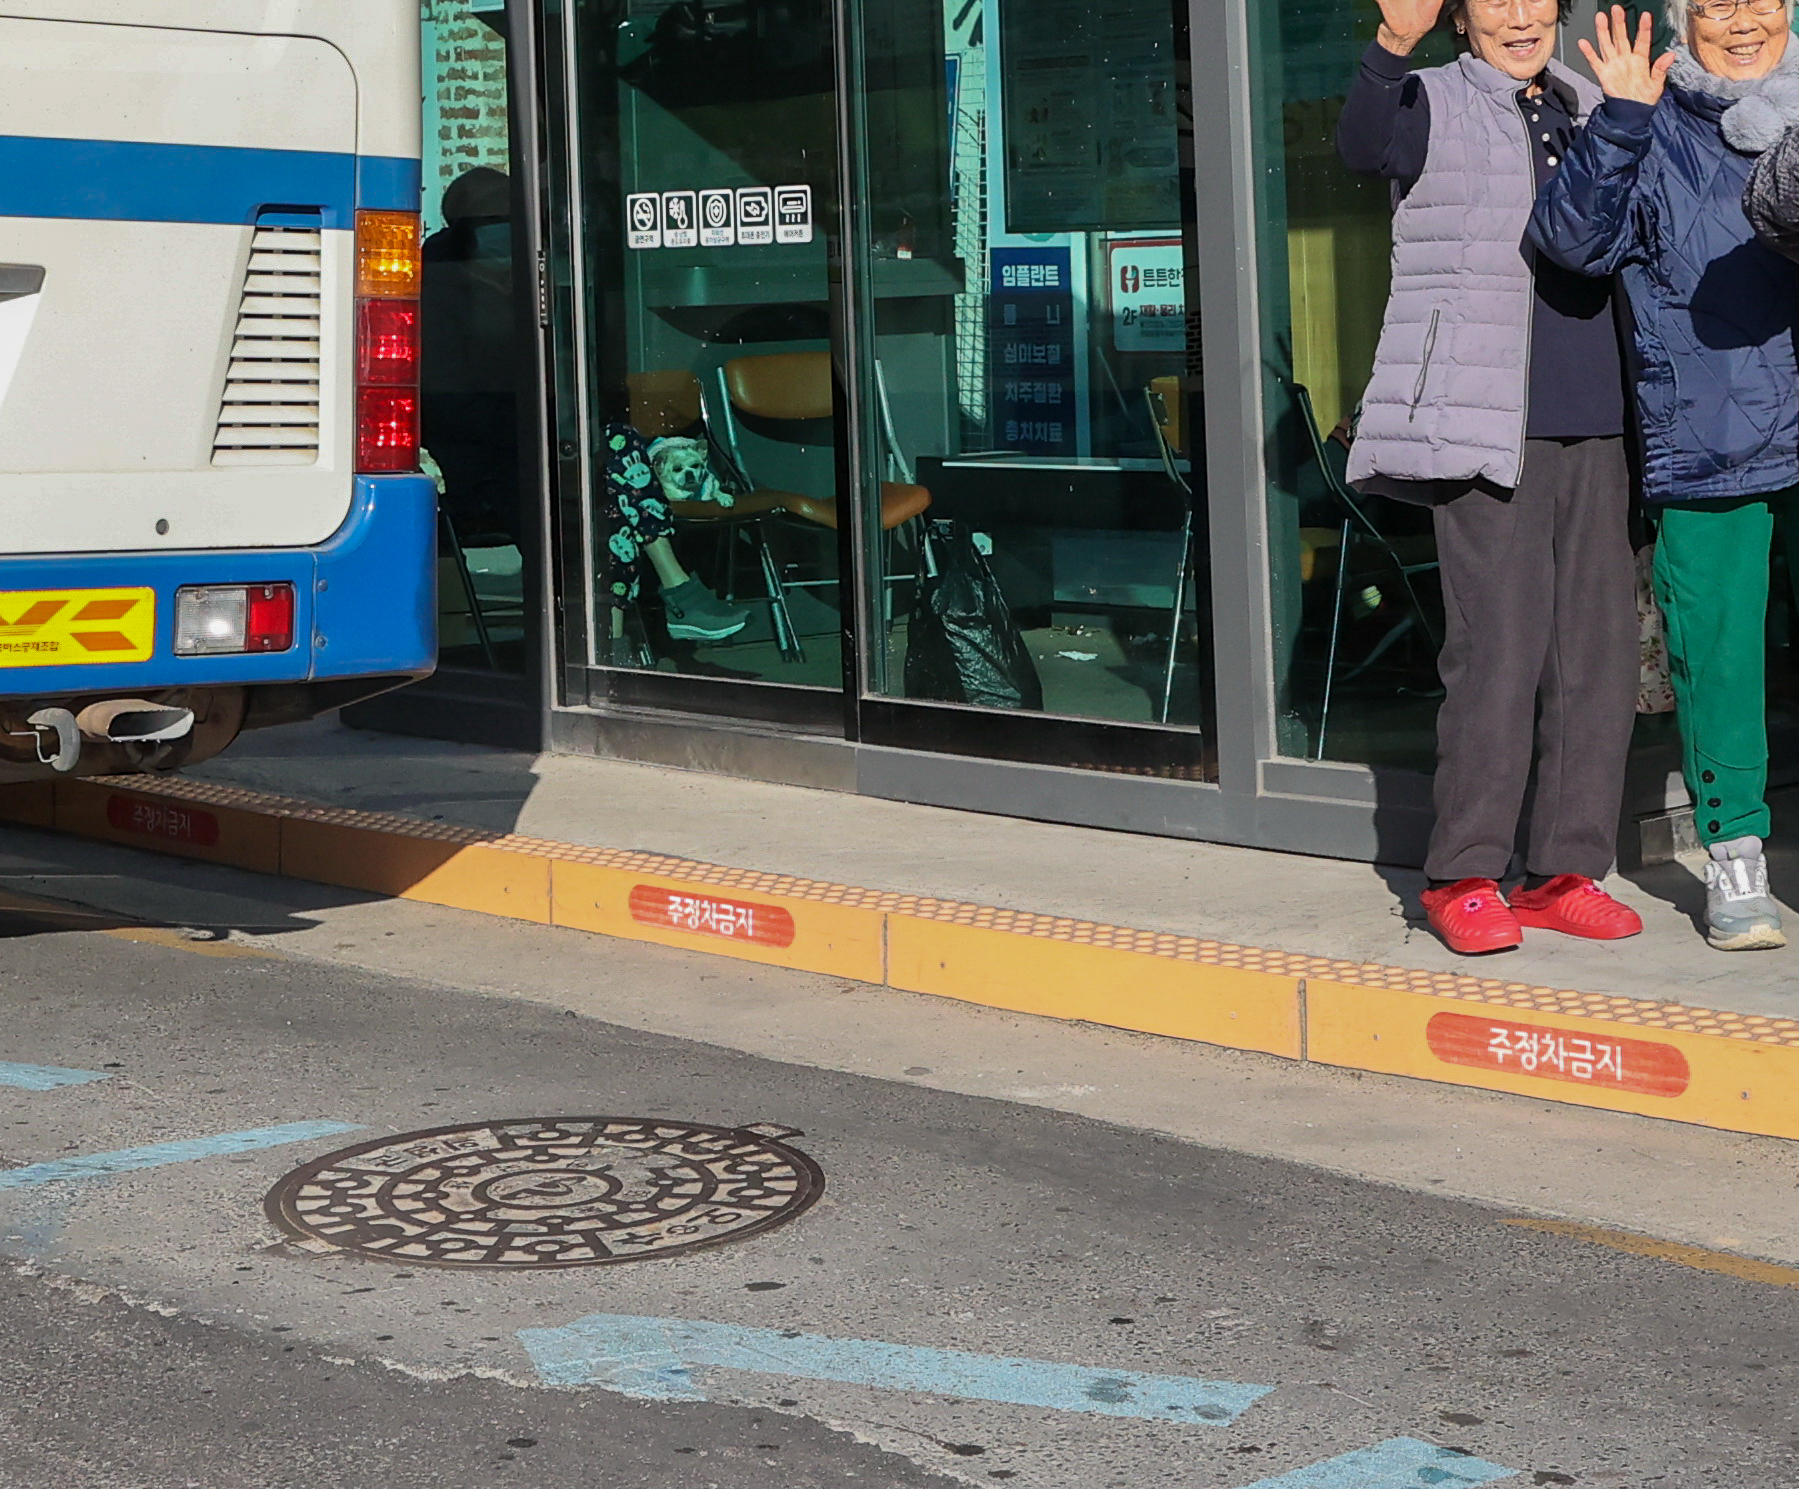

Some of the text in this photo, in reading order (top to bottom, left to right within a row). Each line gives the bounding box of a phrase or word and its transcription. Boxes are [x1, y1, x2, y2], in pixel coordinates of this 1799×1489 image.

[1002, 264, 1060, 288] 임플란트
[1143, 268, 1183, 287] 튼튼한
[133, 804, 191, 838] 주정차금지
[666, 894, 754, 938] 주정차금지
[1487, 1026, 1624, 1081] 주정차금지
